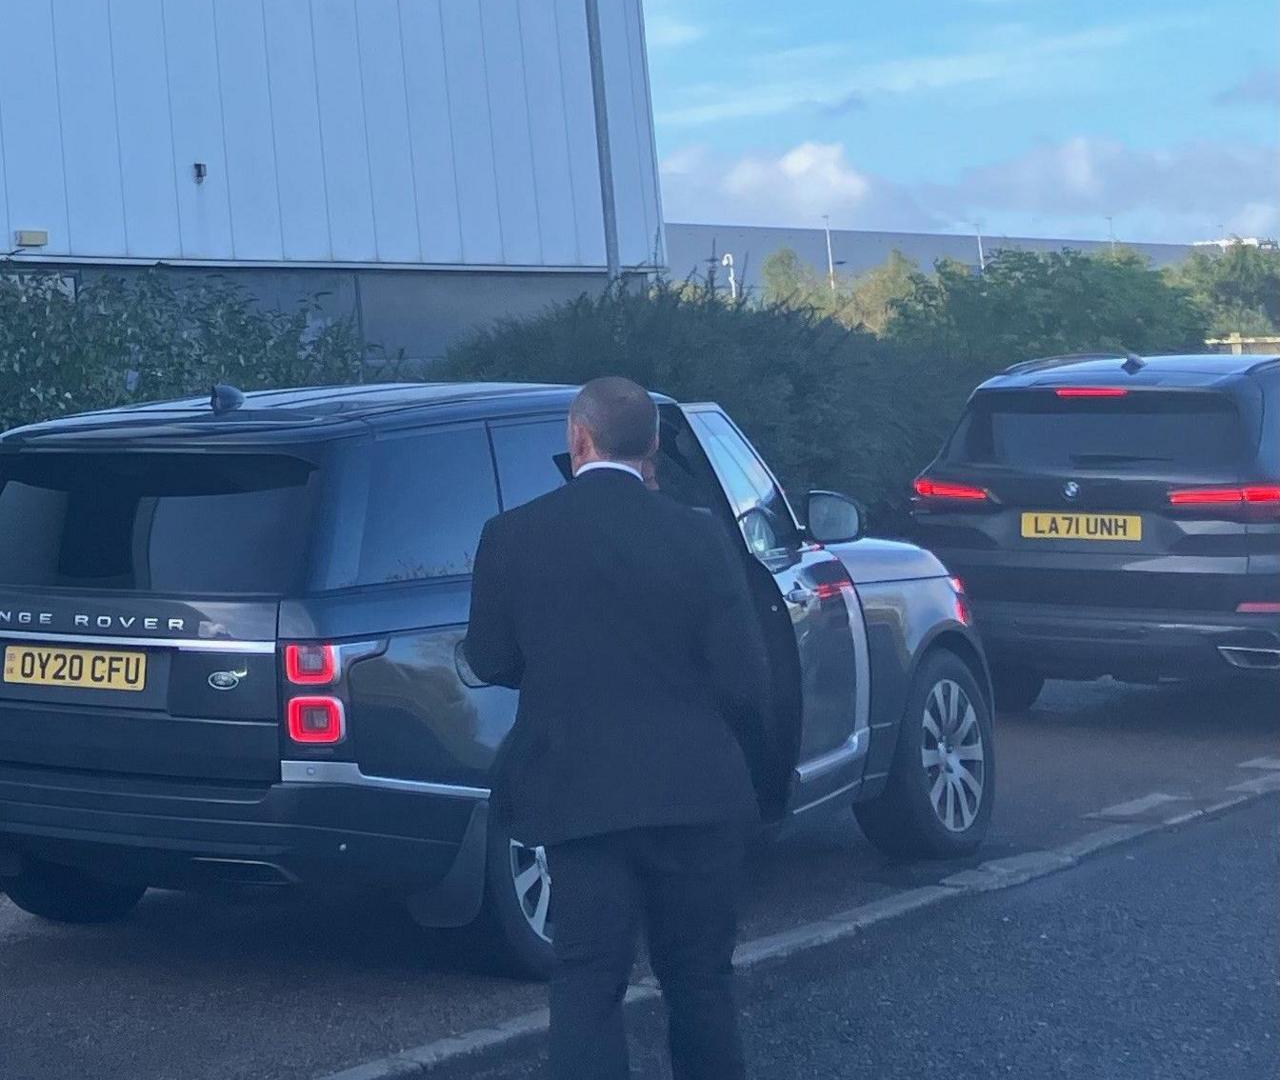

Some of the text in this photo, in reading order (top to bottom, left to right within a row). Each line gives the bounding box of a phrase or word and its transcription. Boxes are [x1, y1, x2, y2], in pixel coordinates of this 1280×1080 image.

[1034, 516, 1128, 536] LA71 UNH
[74, 614, 184, 631] ROVER
[20, 651, 140, 685] OY20 CFU
